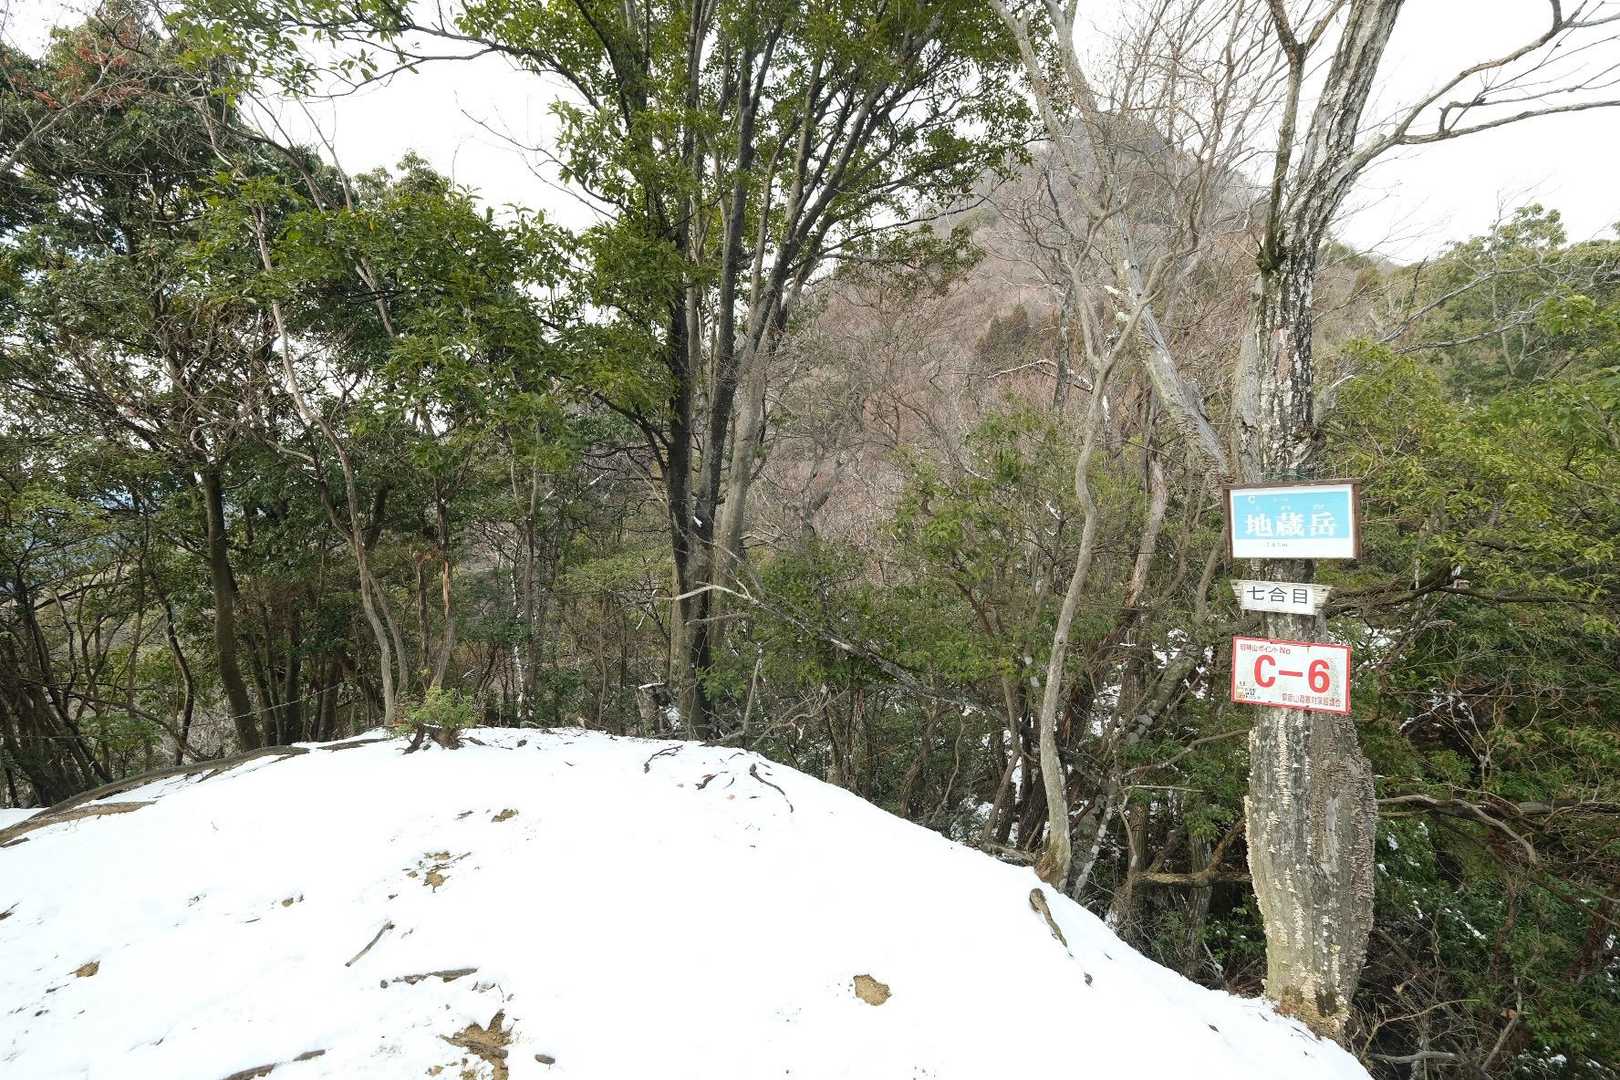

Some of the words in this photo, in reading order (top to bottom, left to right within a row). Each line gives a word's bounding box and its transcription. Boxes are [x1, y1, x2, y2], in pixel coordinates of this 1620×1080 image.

[1245, 511, 1336, 537] 地蔵岳
[1246, 586, 1308, 604] 七合目
